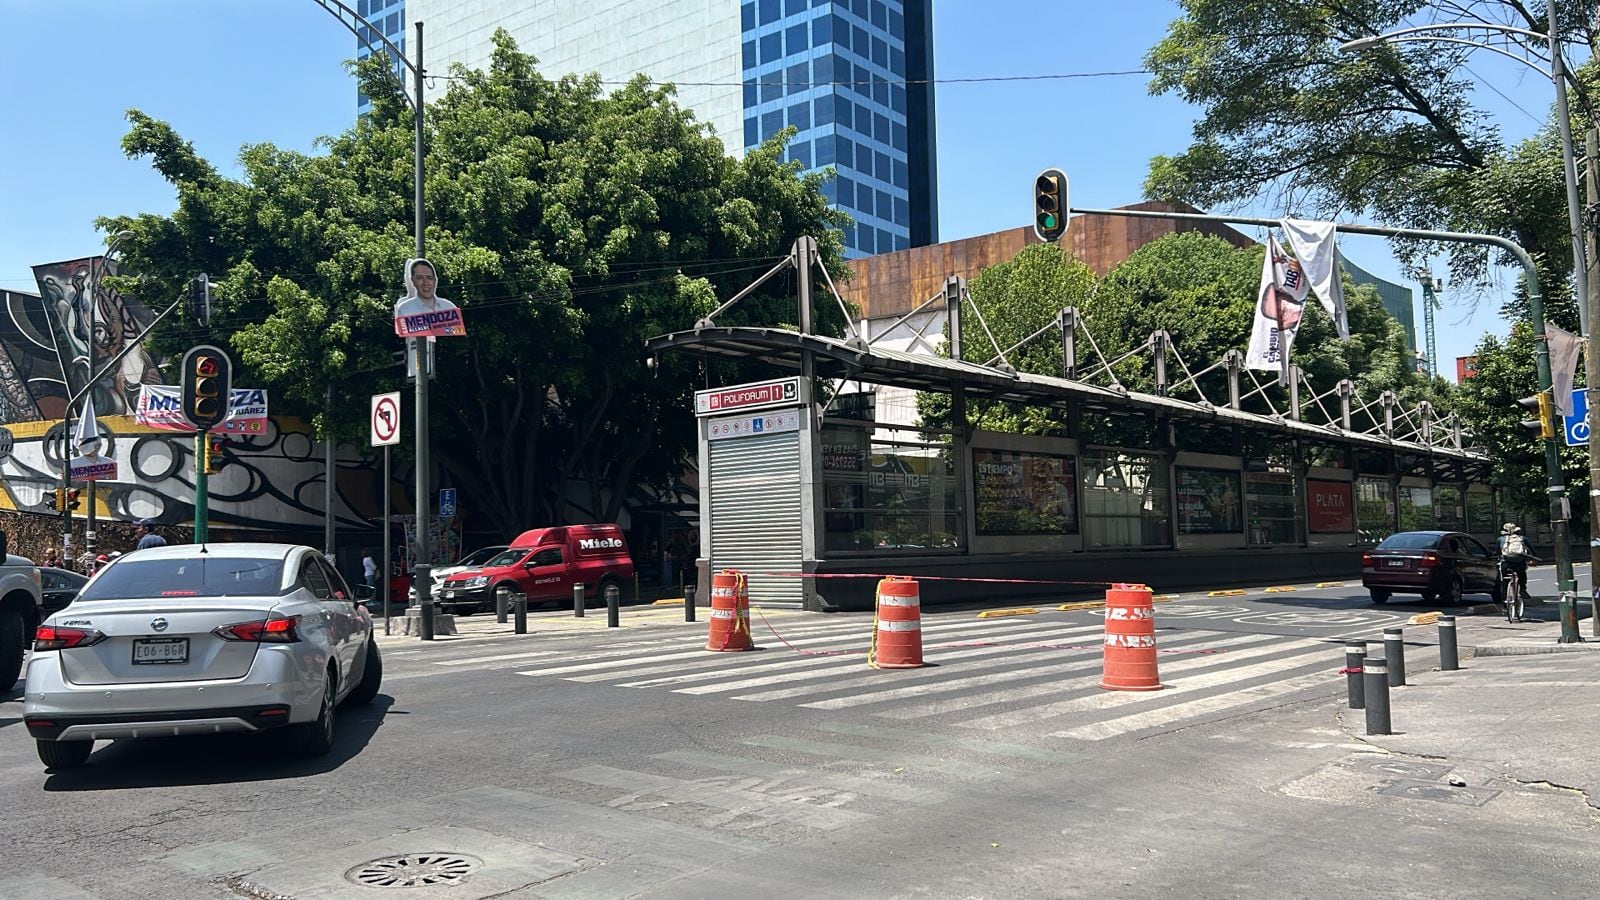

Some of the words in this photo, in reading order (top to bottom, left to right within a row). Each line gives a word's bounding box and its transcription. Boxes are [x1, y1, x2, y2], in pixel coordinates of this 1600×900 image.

[405, 309, 460, 327] MENDOZA
[1268, 327, 1279, 363] CAMBIO
[149, 390, 265, 410] MEZA
[724, 390, 769, 404] POLIFORUM
[775, 387, 779, 398] 1
[235, 407, 265, 415] JUÁREZ
[70, 462, 115, 477] MENDOZA
[445, 490, 451, 500] E
[1316, 493, 1345, 507] PLATA
[579, 538, 622, 550] Miele
[137, 645, 184, 658] E06-BGR
